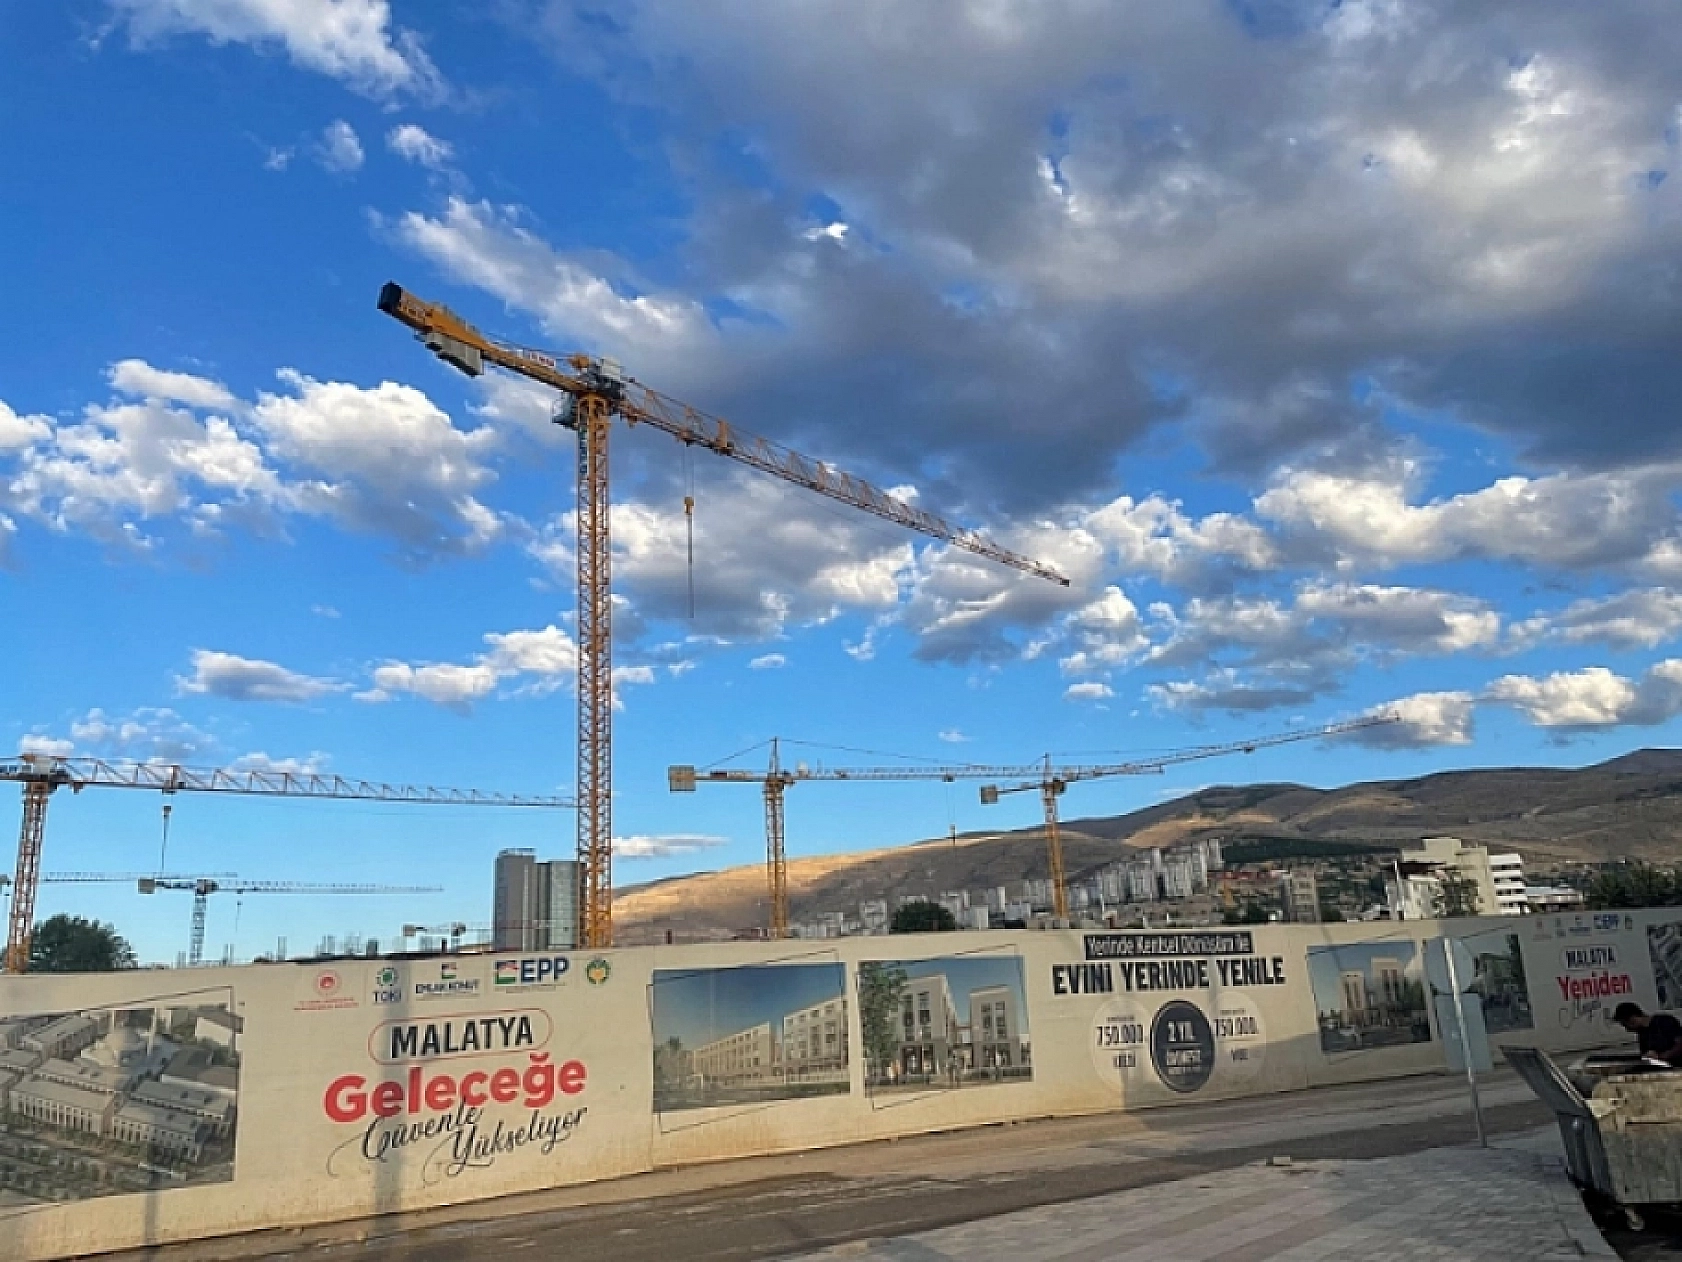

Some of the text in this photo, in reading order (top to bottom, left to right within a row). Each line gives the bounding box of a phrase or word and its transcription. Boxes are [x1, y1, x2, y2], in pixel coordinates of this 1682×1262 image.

[521, 957, 569, 982] EPP
[1052, 956, 1286, 995] EVİNİ YERİNDE YENİLE
[1556, 971, 1632, 1001] Yeniden
[391, 1015, 534, 1058] MALATYA
[324, 1052, 587, 1122] Geleceğe
[345, 1097, 484, 1169] Güvenle
[438, 1106, 588, 1180] Yükseliyor
